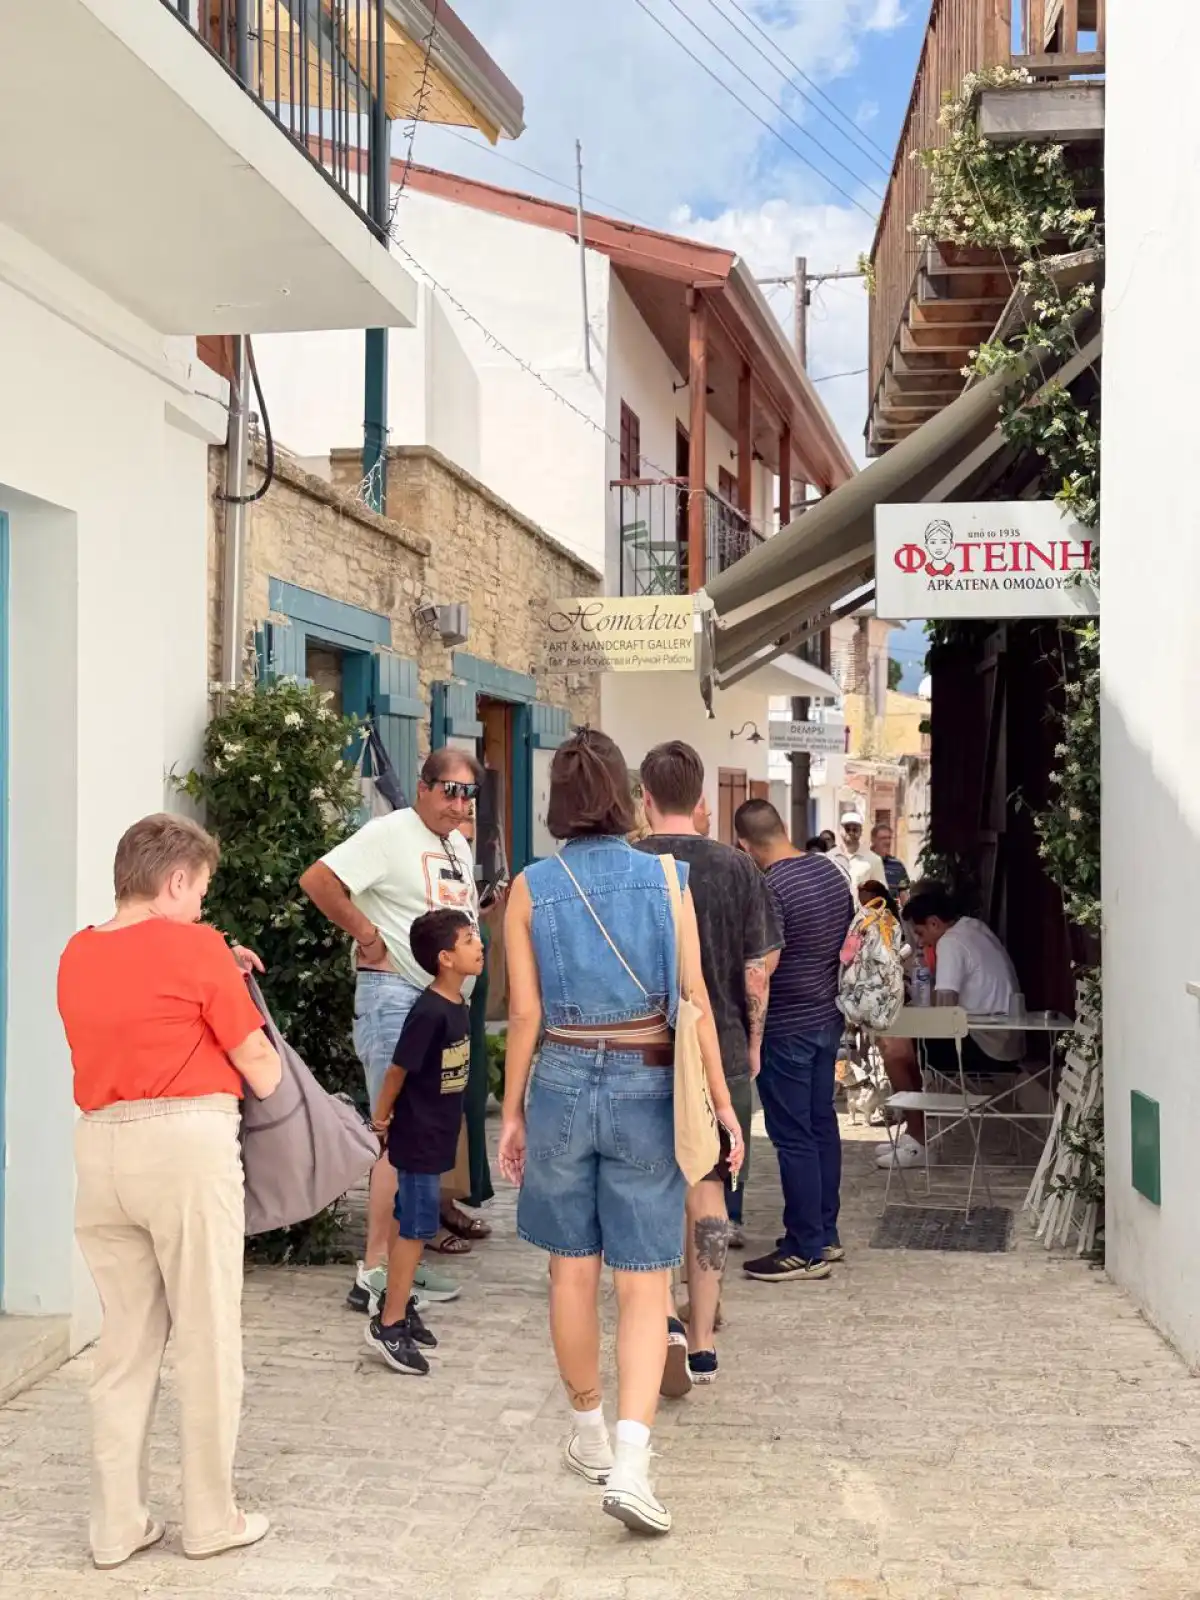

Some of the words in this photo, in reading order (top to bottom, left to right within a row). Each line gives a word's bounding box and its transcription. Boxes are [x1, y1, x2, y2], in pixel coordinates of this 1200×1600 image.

[987, 530, 996, 539] το
[999, 528, 1021, 538] 1935
[927, 577, 999, 591] ΑΡΚΑΤΕΝΑ
[547, 602, 691, 633] Homodeus
[549, 640, 568, 653] ART
[571, 640, 580, 652] &
[583, 639, 645, 652] HANDCRAFT
[647, 638, 692, 651] GALLERY
